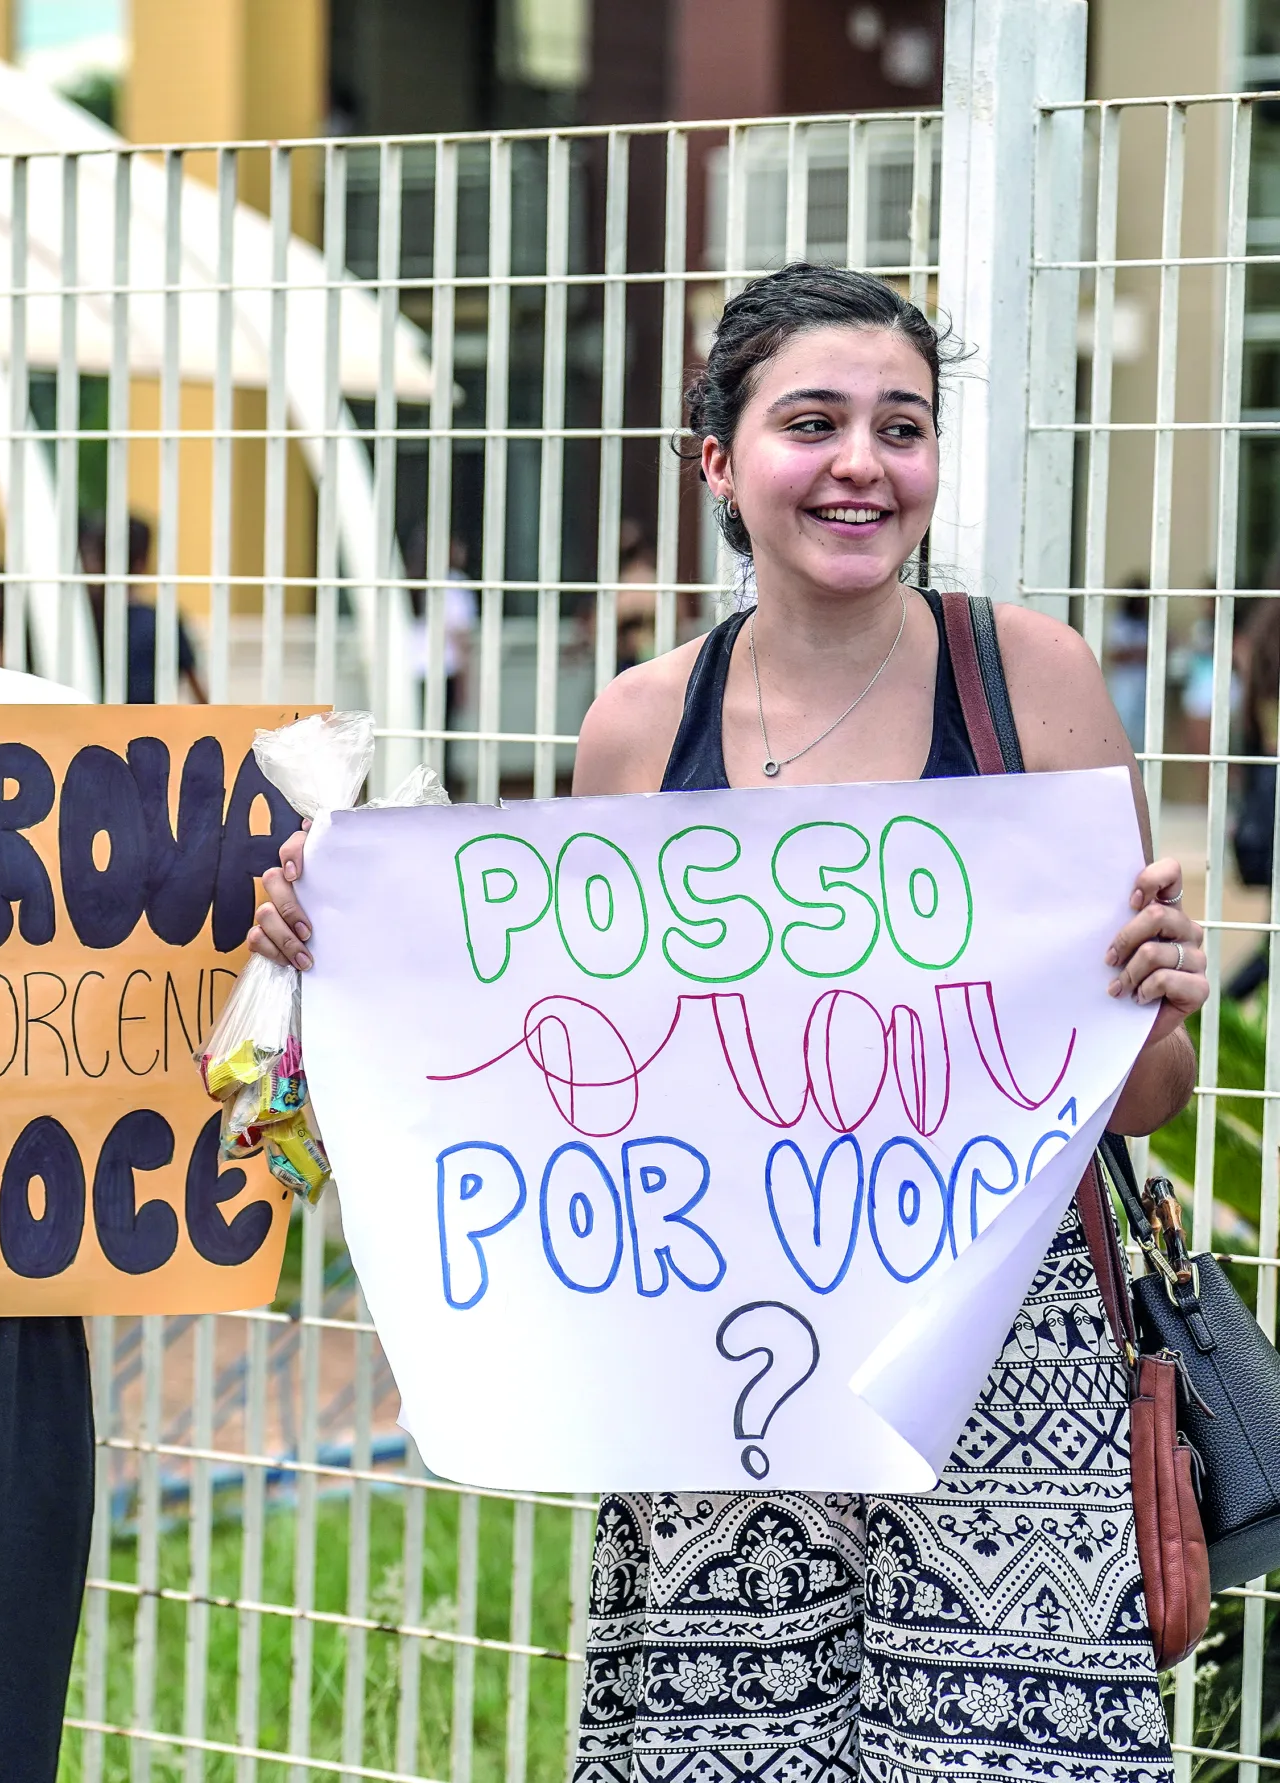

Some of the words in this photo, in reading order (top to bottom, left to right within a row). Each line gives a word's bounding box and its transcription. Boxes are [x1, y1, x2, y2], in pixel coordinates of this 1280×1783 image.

[454, 815, 973, 983] POSSO
[436, 1133, 728, 1310] POR
[716, 1300, 820, 1479] ?
